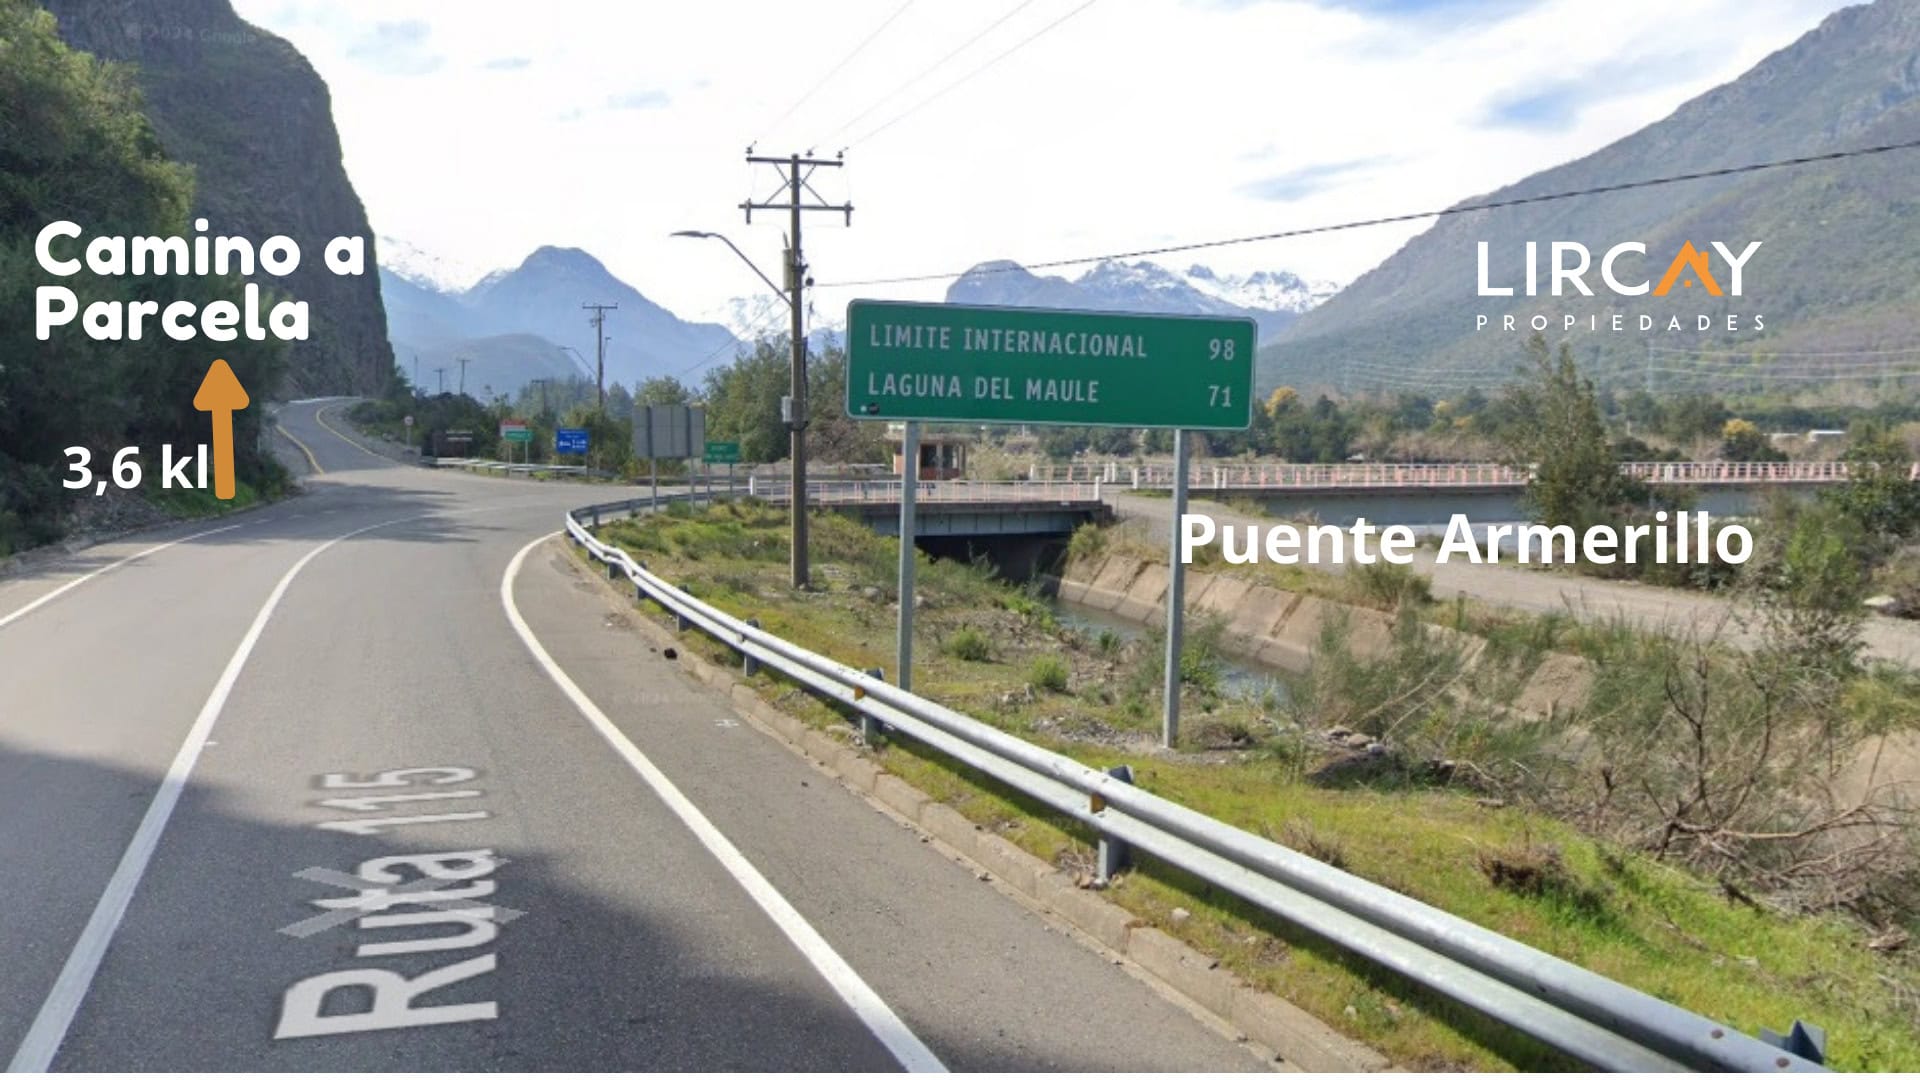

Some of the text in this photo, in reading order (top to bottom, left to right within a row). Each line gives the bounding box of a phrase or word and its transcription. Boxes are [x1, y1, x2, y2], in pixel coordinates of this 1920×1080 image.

[869, 323, 1235, 361] LIMITE INTERNACIONAL 98
[868, 372, 1232, 408] LAGUNA DEL MAULE 71
[273, 766, 498, 1039] Ruta 115
